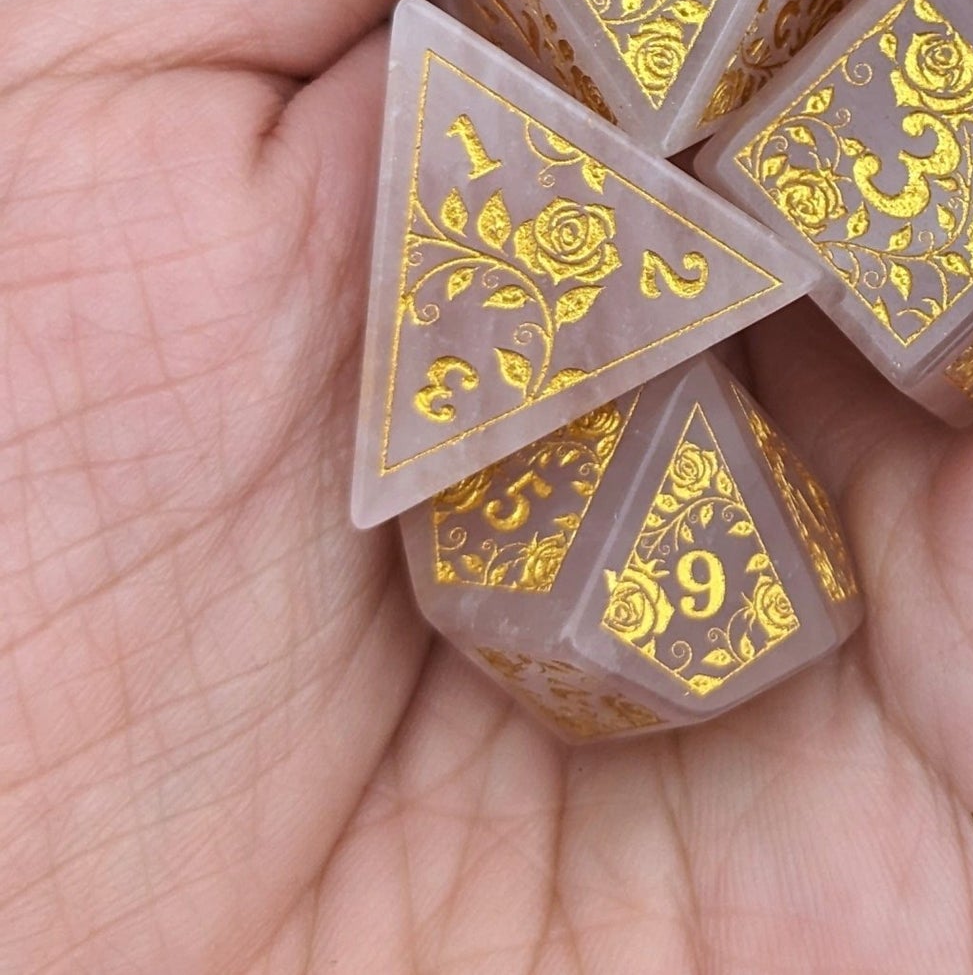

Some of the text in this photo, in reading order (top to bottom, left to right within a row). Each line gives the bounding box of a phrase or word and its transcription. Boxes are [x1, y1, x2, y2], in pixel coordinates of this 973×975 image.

[445, 114, 502, 180] 1
[853, 112, 961, 218] 3
[640, 250, 708, 298] 2
[414, 356, 478, 422] 3
[485, 470, 552, 530] 5
[675, 549, 727, 618] 9
